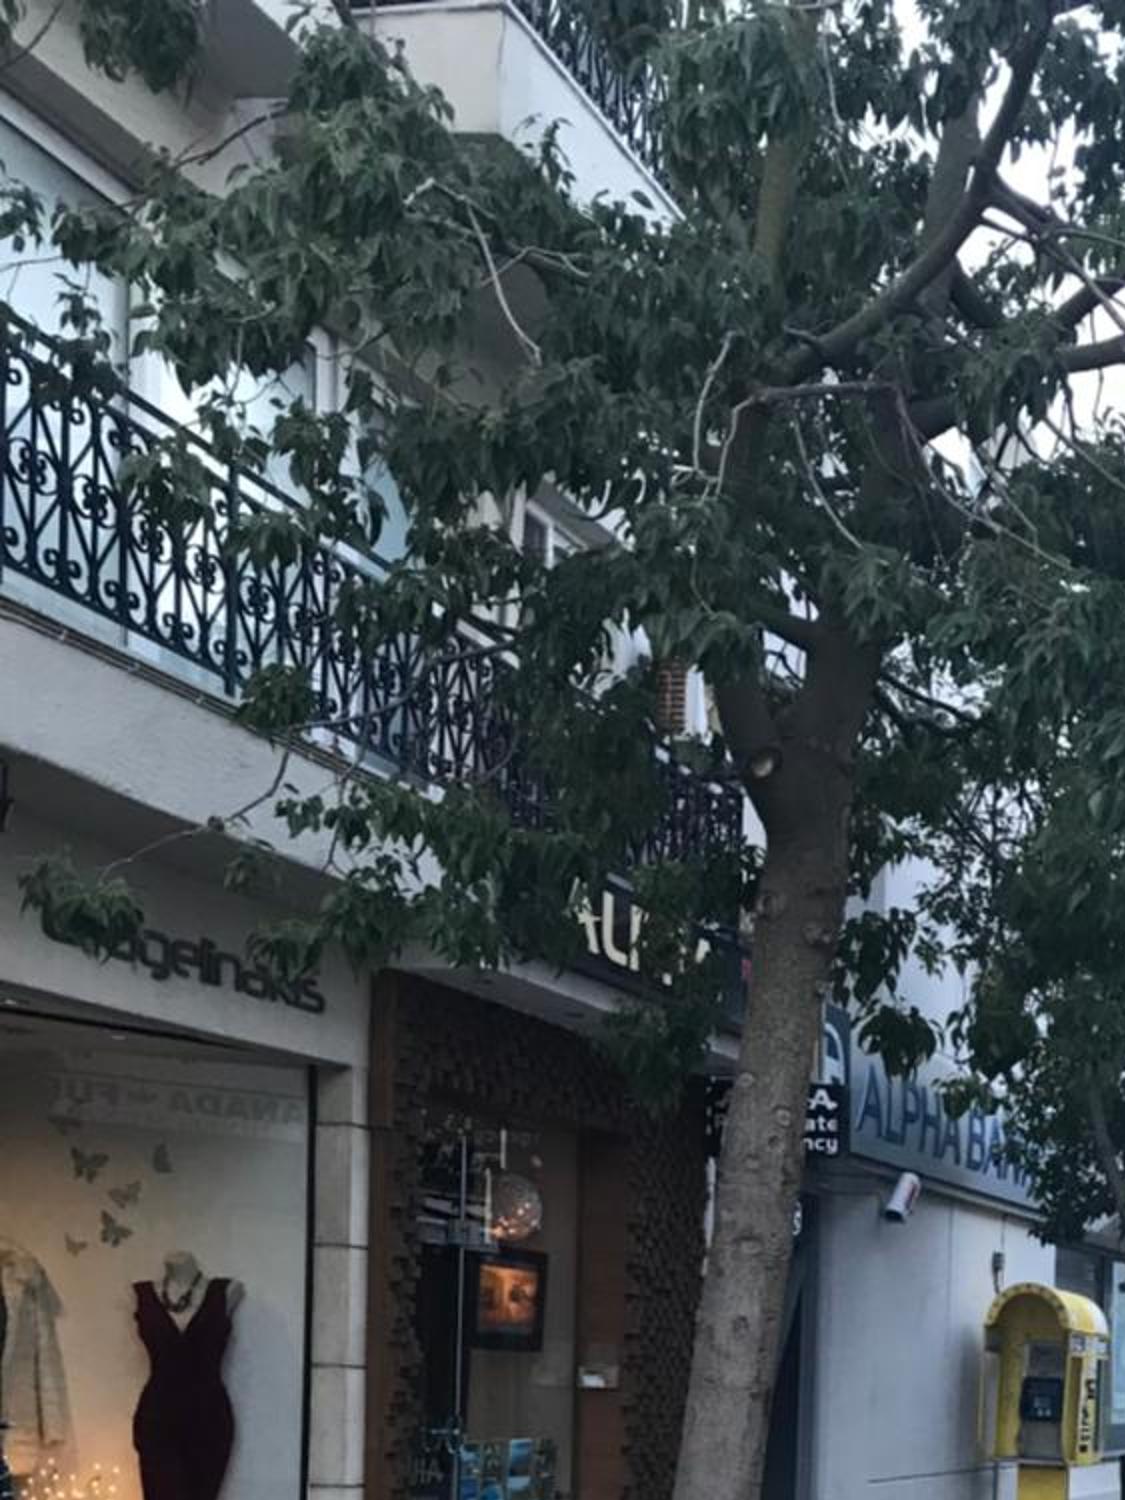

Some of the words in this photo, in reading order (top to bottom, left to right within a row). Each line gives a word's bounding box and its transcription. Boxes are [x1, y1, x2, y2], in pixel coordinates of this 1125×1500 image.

[803, 1114, 839, 1132] ate
[855, 1062, 961, 1167] ALPHA
[966, 1107, 1034, 1197] BA
[802, 1137, 839, 1155] ncy
